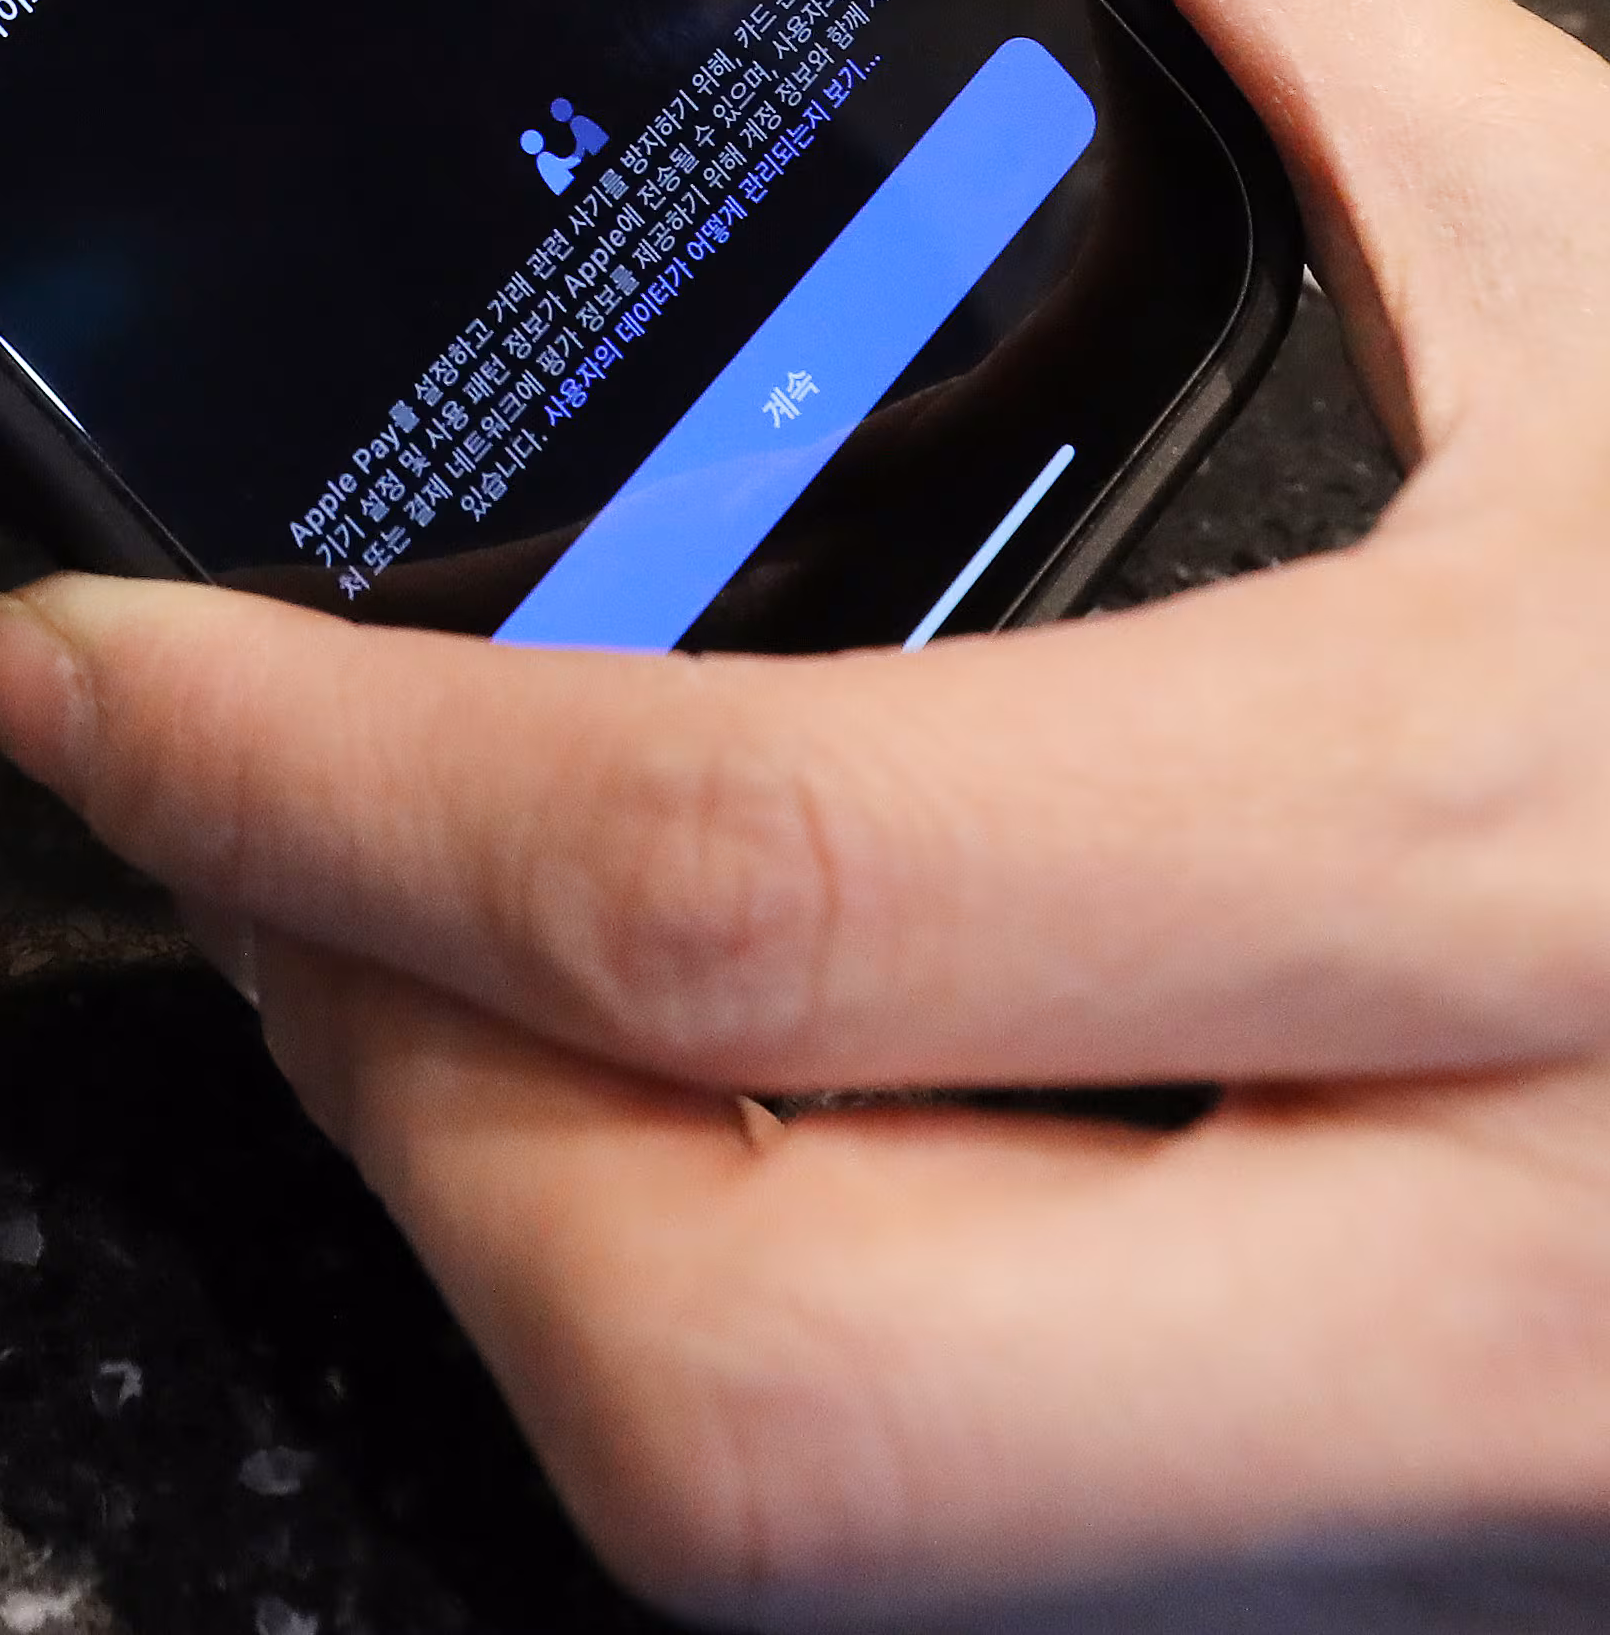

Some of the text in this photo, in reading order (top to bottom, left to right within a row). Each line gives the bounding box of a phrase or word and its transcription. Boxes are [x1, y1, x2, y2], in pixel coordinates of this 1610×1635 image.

[289, 472, 358, 549] Apple
[414, 317, 495, 407] 설정하고
[486, 270, 537, 323] 거래
[525, 228, 575, 281] 관련
[568, 168, 630, 236] 사기를
[619, 89, 700, 175] 방지하기
[691, 47, 743, 95] 위해,
[733, 3, 778, 49] 카드
[403, 472, 454, 528] 결제
[535, 326, 585, 377] 평가
[631, 183, 711, 270] 제공하기
[702, 141, 748, 189] 위해
[739, 100, 782, 149] 계정
[774, 42, 835, 107] 정보와
[825, 0, 871, 50] 함께
[425, 400, 470, 450] 사용
[501, 290, 568, 360] 정보가
[563, 202, 646, 299] Apple에
[636, 142, 700, 211] 전송될
[694, 125, 716, 148] 수
[712, 60, 780, 129] 있으며,
[459, 55, 881, 523] 있습니다. 사용자의 데이터가 어떻게 관리되는지 보기...
[761, 369, 821, 429] 계속
